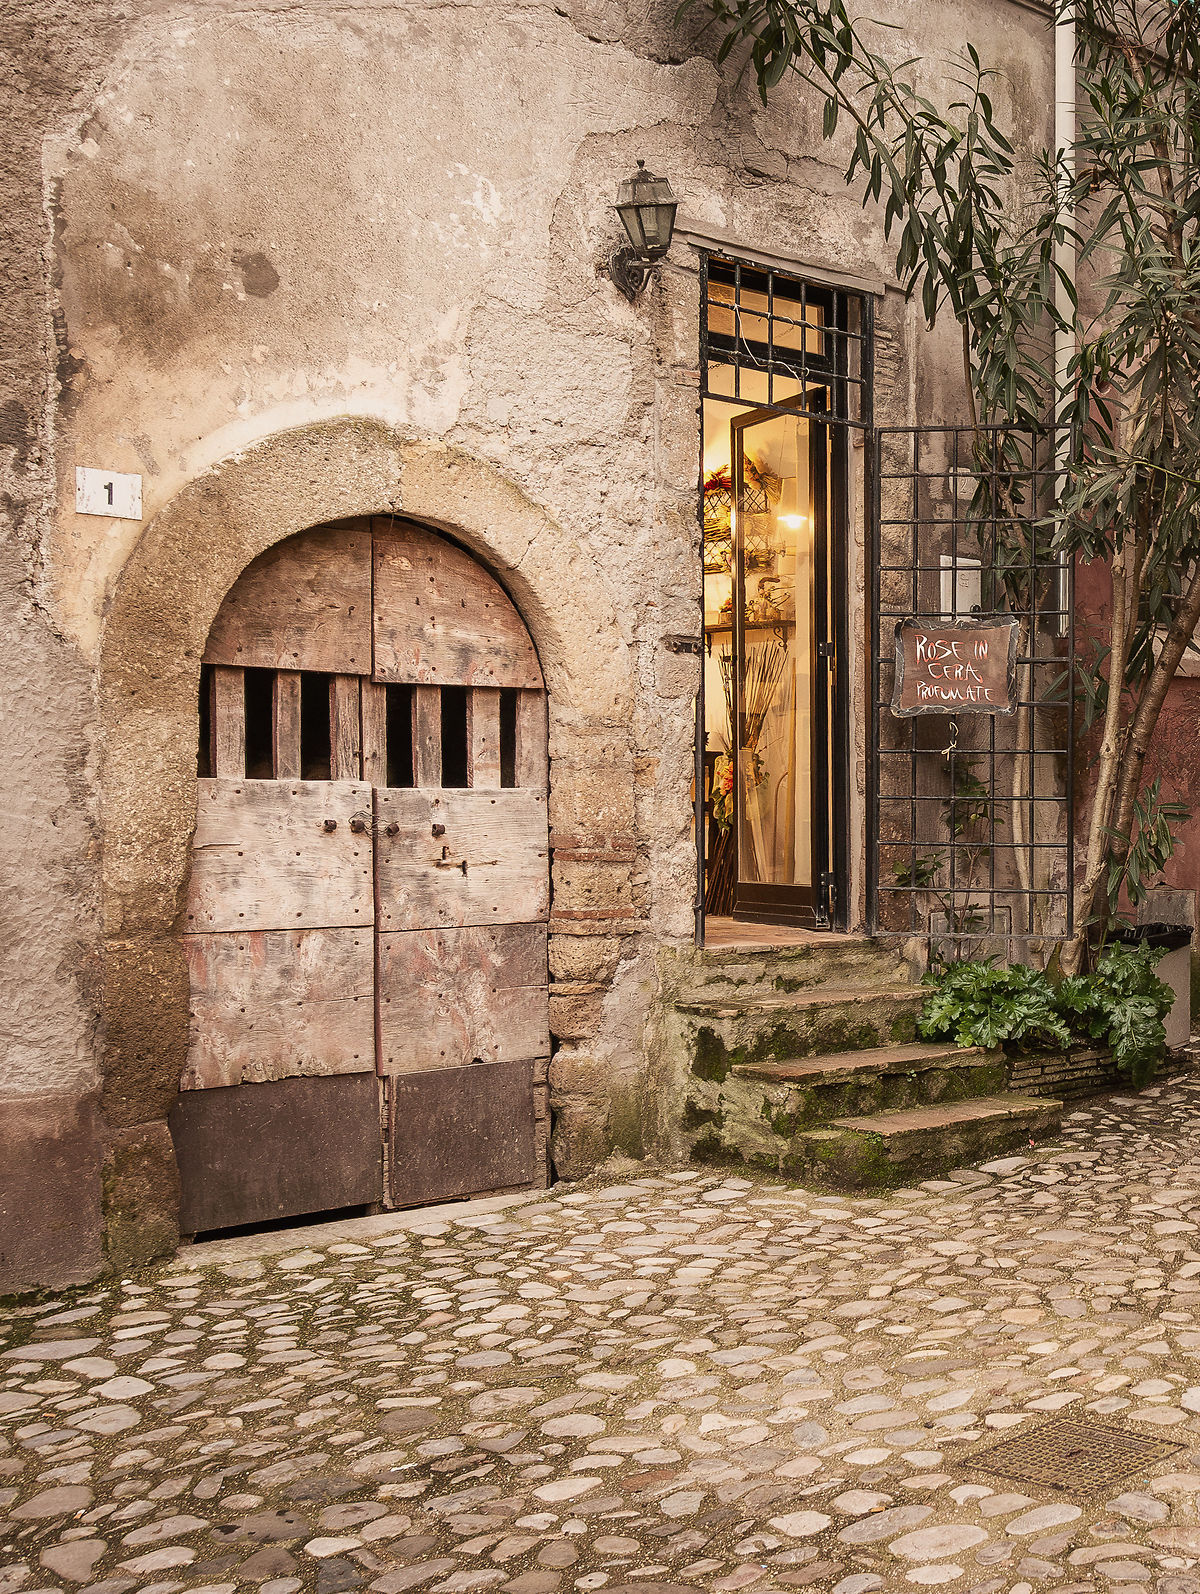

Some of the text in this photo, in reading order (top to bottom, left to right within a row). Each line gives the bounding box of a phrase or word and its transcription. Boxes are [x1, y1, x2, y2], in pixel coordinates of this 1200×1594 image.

[103, 481, 113, 506] 1
[914, 634, 988, 664] ROSE IN
[927, 661, 984, 683] CERA
[916, 681, 994, 702] PROFUMATE
